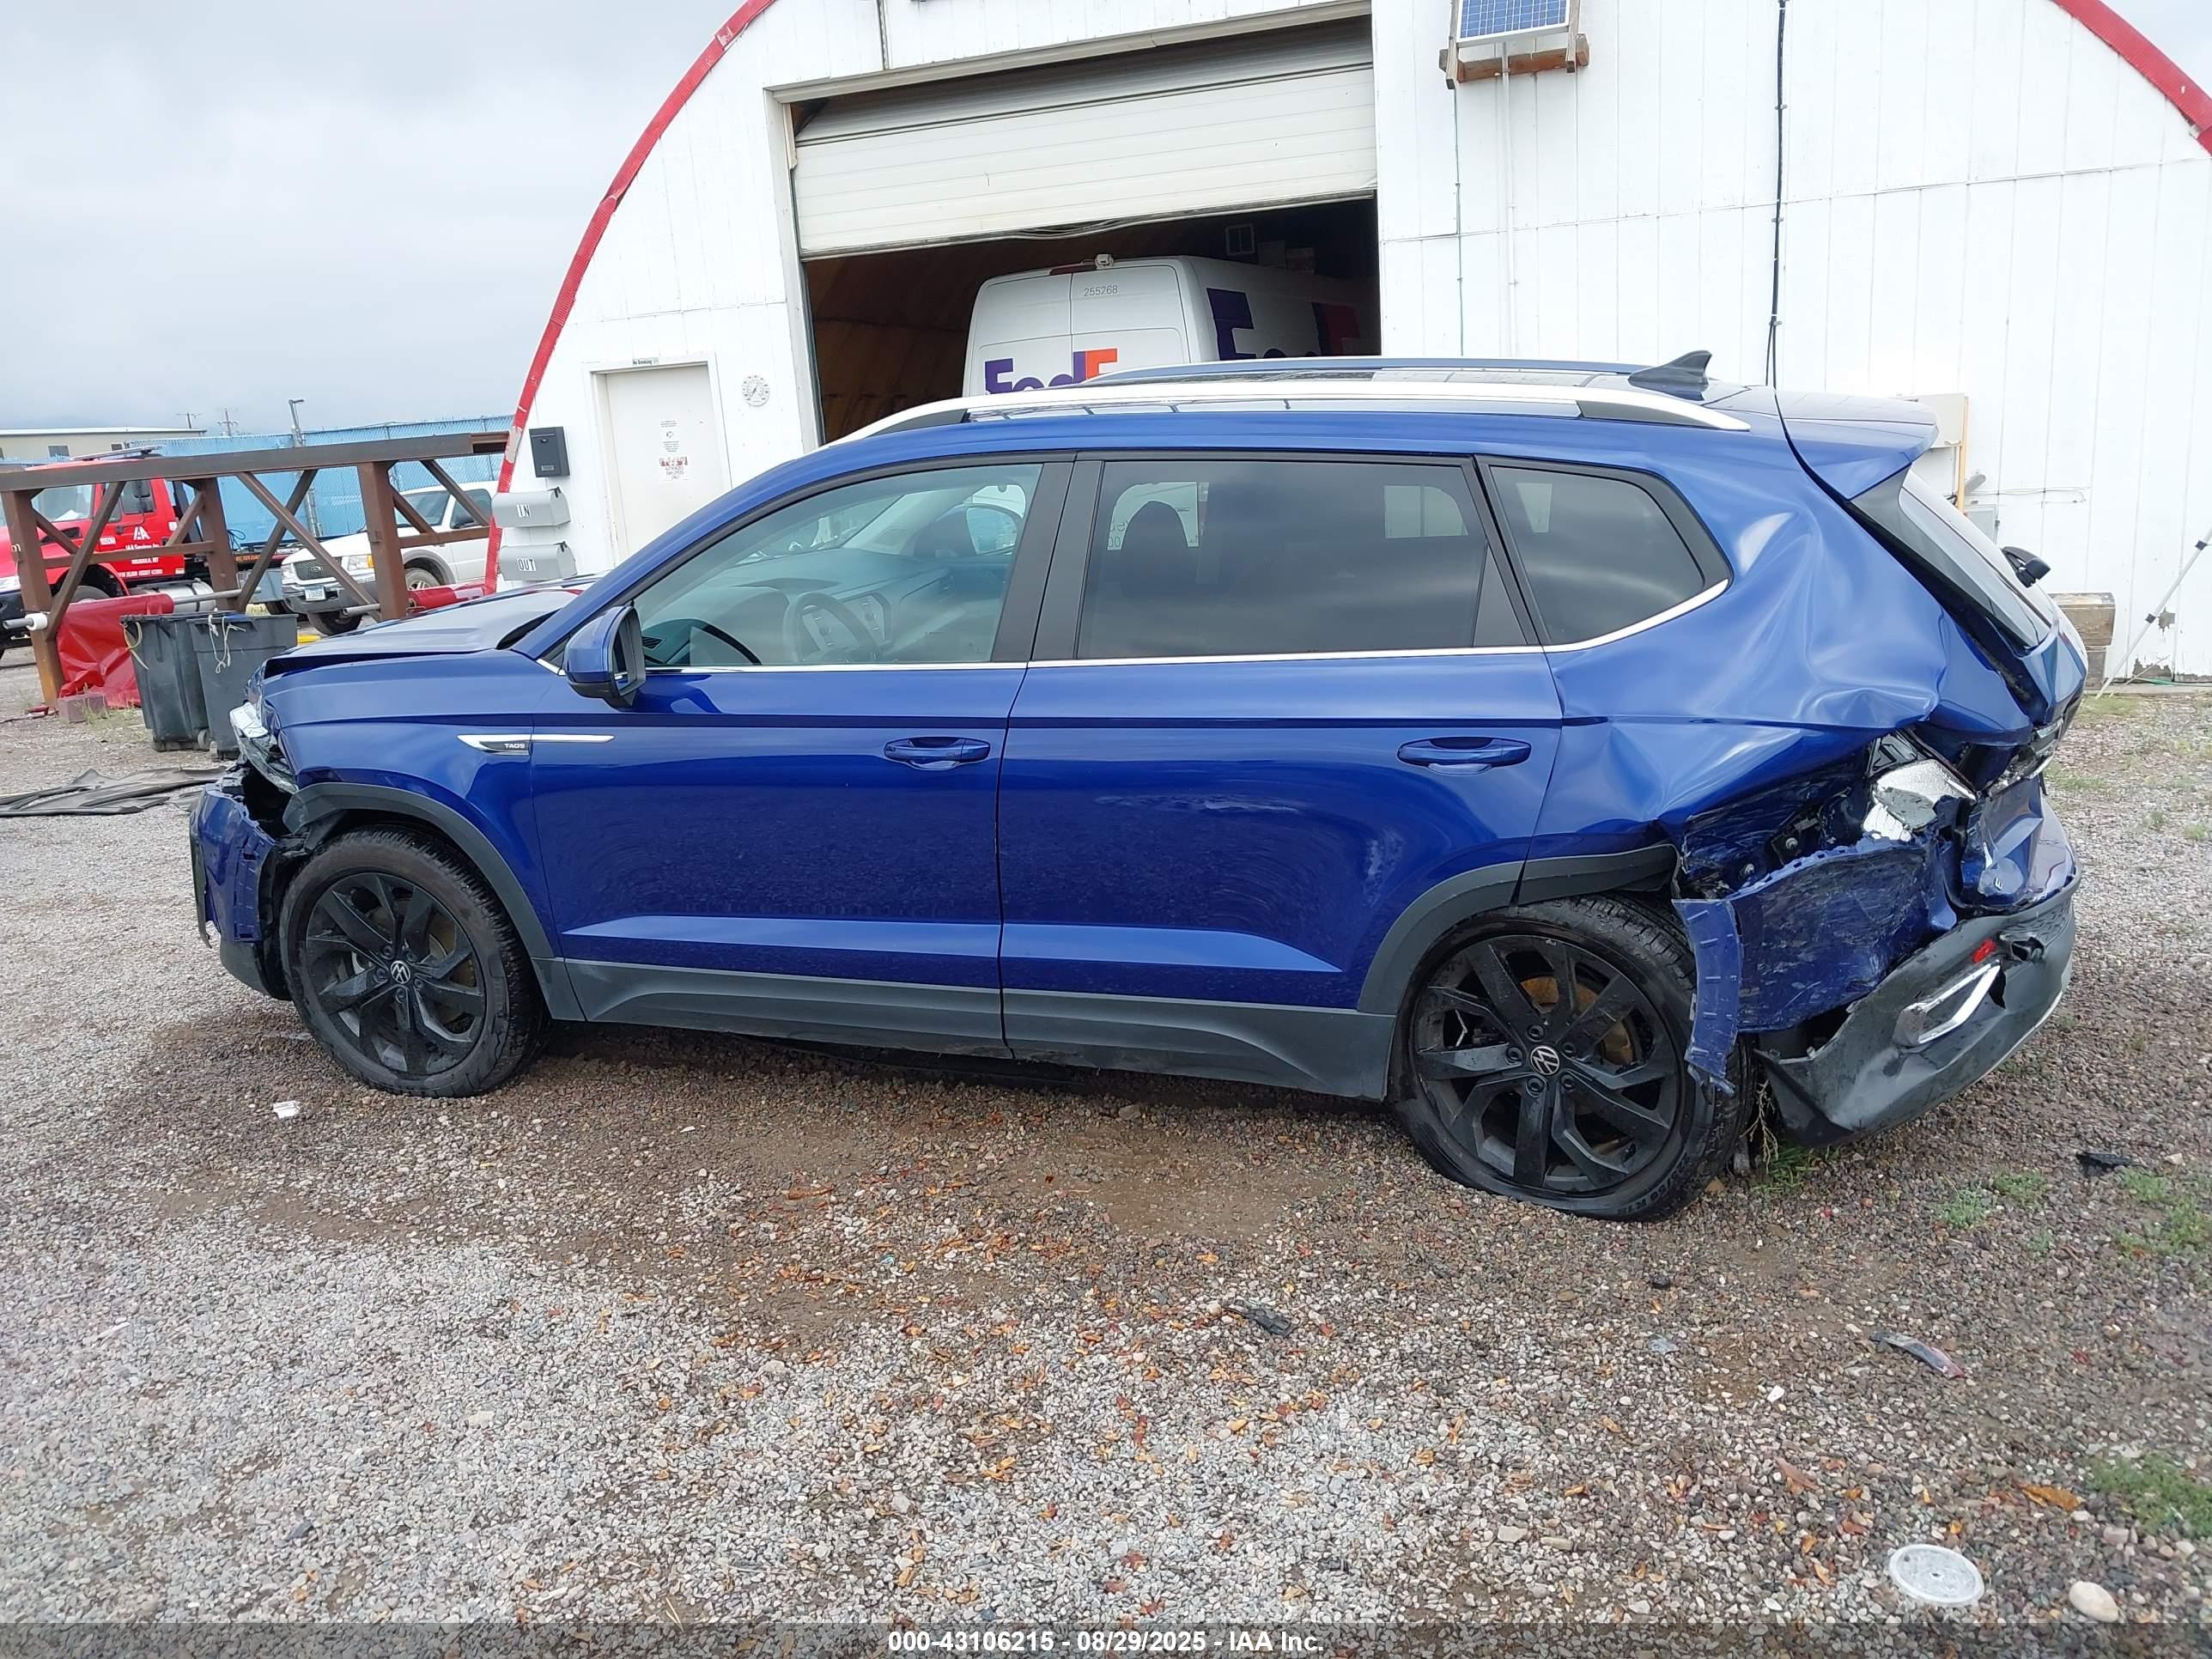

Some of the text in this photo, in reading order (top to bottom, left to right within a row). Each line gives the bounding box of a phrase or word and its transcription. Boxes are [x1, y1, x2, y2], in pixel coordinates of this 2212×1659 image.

[1084, 284, 1118, 297] 255268
[519, 505, 531, 517] IN
[518, 558, 534, 571] OUT
